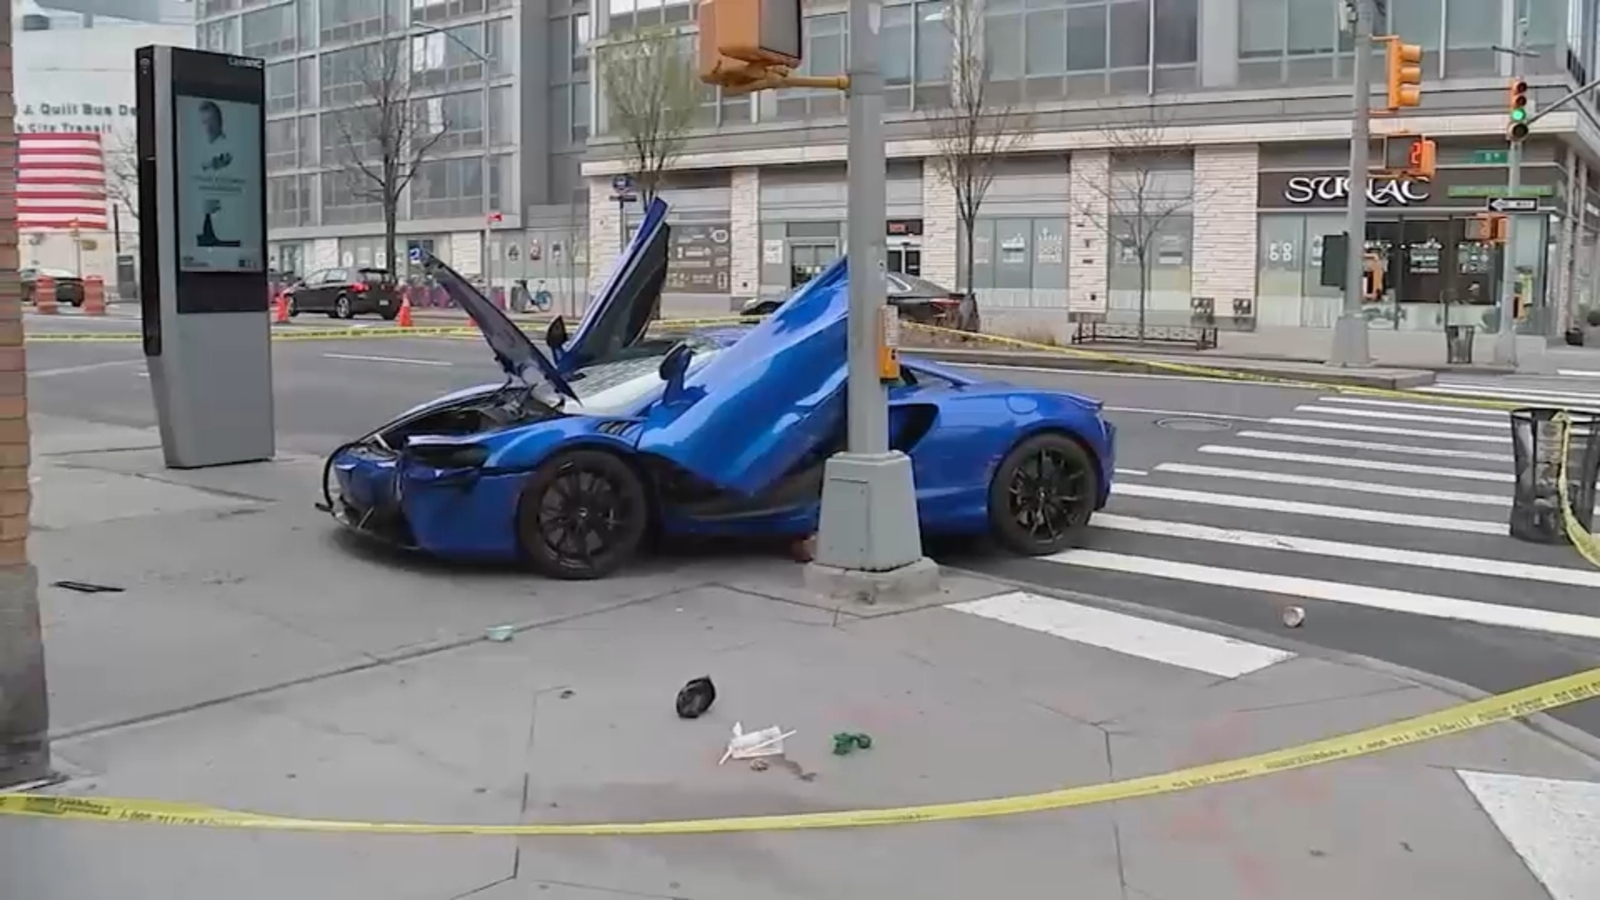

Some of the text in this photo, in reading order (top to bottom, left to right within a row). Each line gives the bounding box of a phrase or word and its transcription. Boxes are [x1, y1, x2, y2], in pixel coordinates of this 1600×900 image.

[41, 103, 78, 115] Quill
[82, 103, 112, 115] Bus
[29, 123, 56, 133] City
[60, 122, 112, 133] Transit
